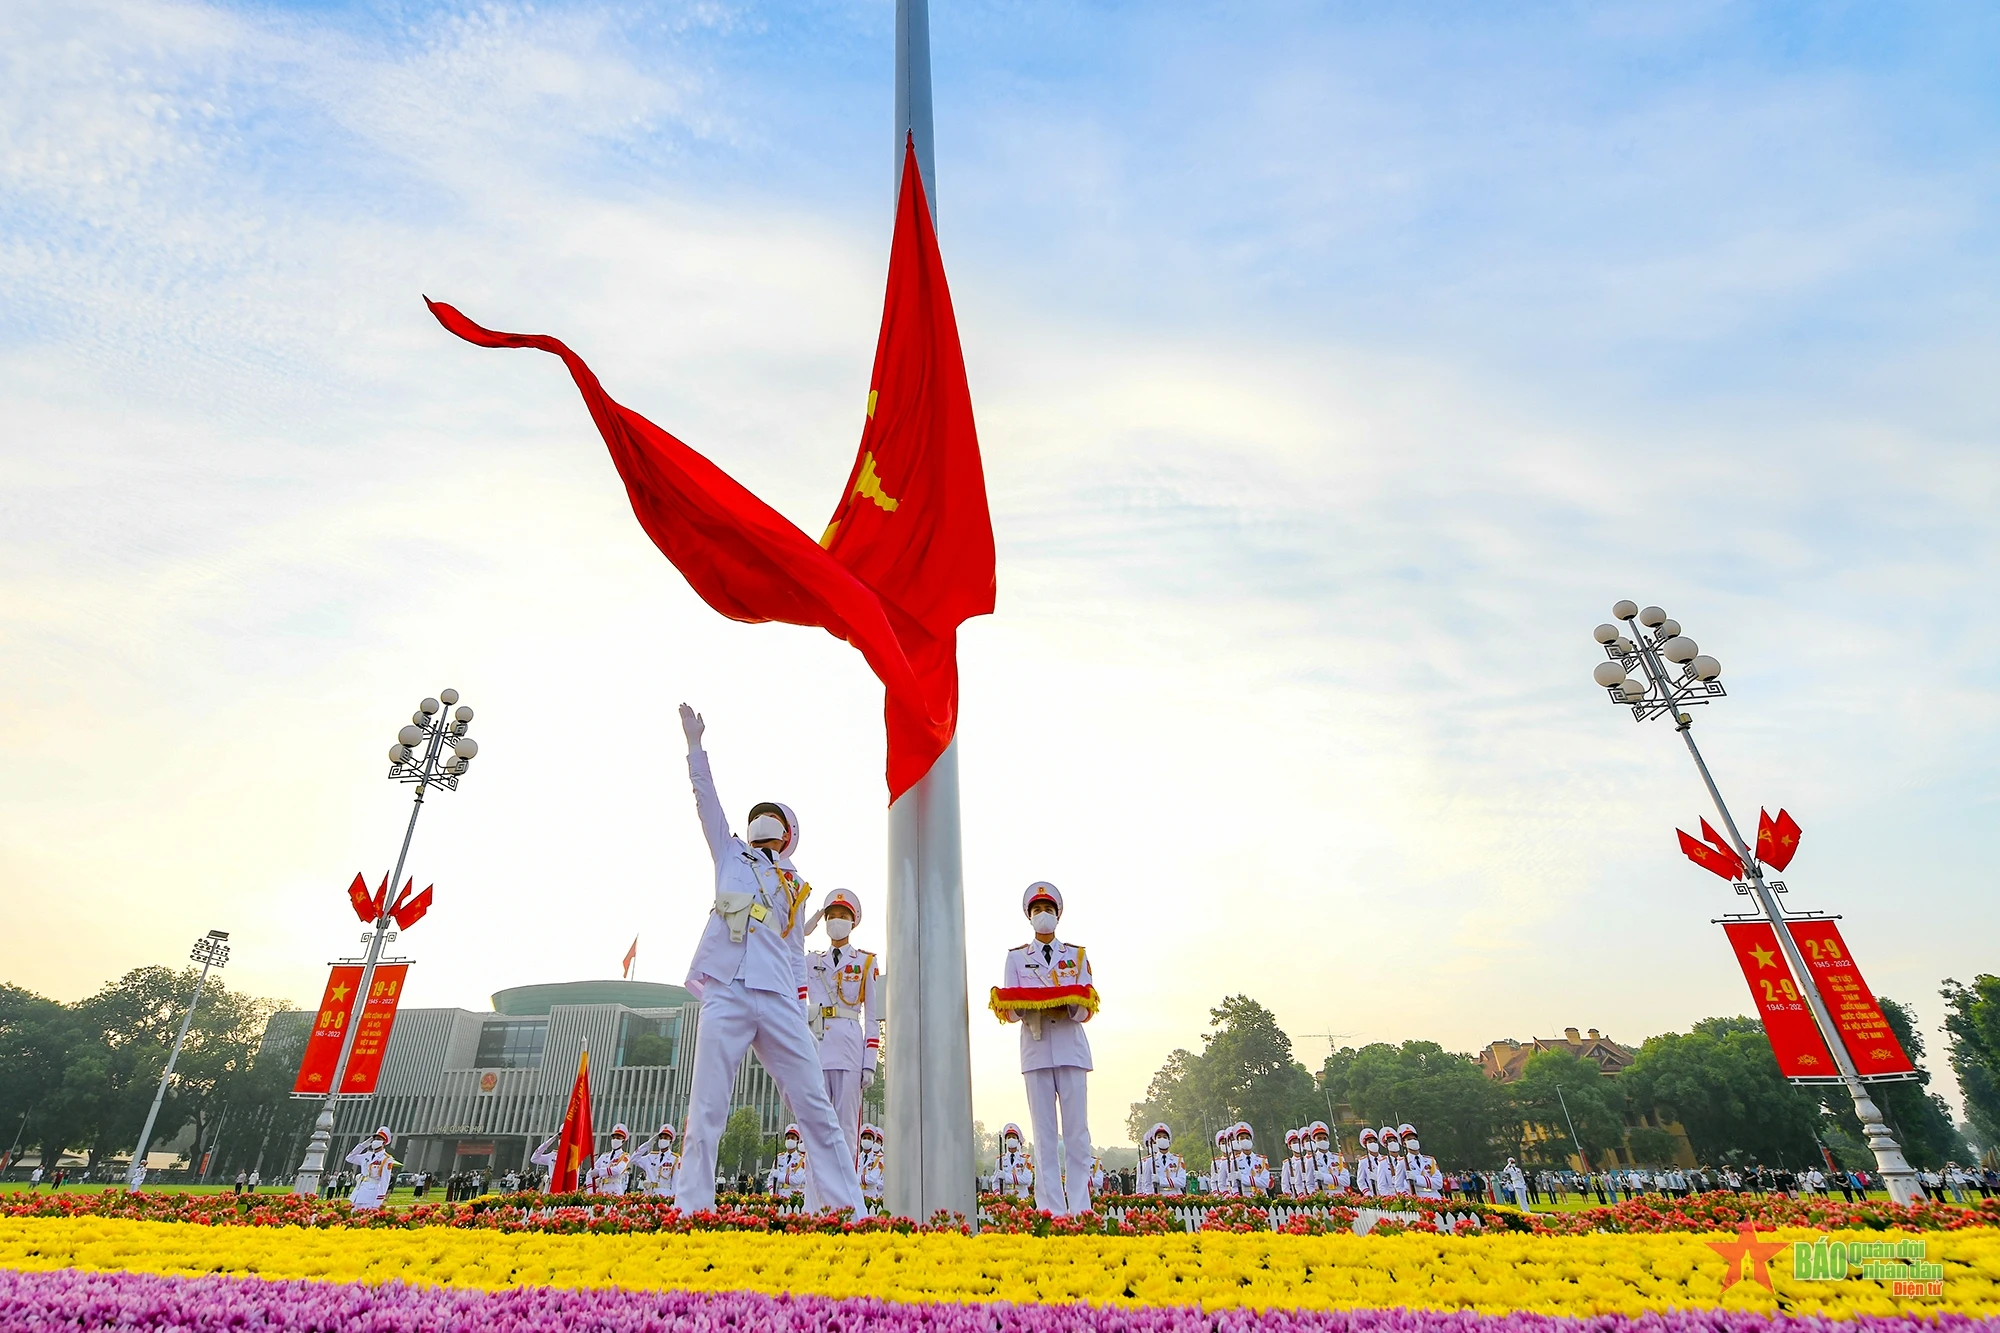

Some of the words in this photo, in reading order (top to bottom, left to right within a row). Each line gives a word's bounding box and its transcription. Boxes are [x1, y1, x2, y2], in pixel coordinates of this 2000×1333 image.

[1805, 939, 1842, 960] 2-9
[372, 980, 397, 997] 19-8
[1760, 979, 1798, 1002] 2-9
[320, 1010, 345, 1029] 19-8
